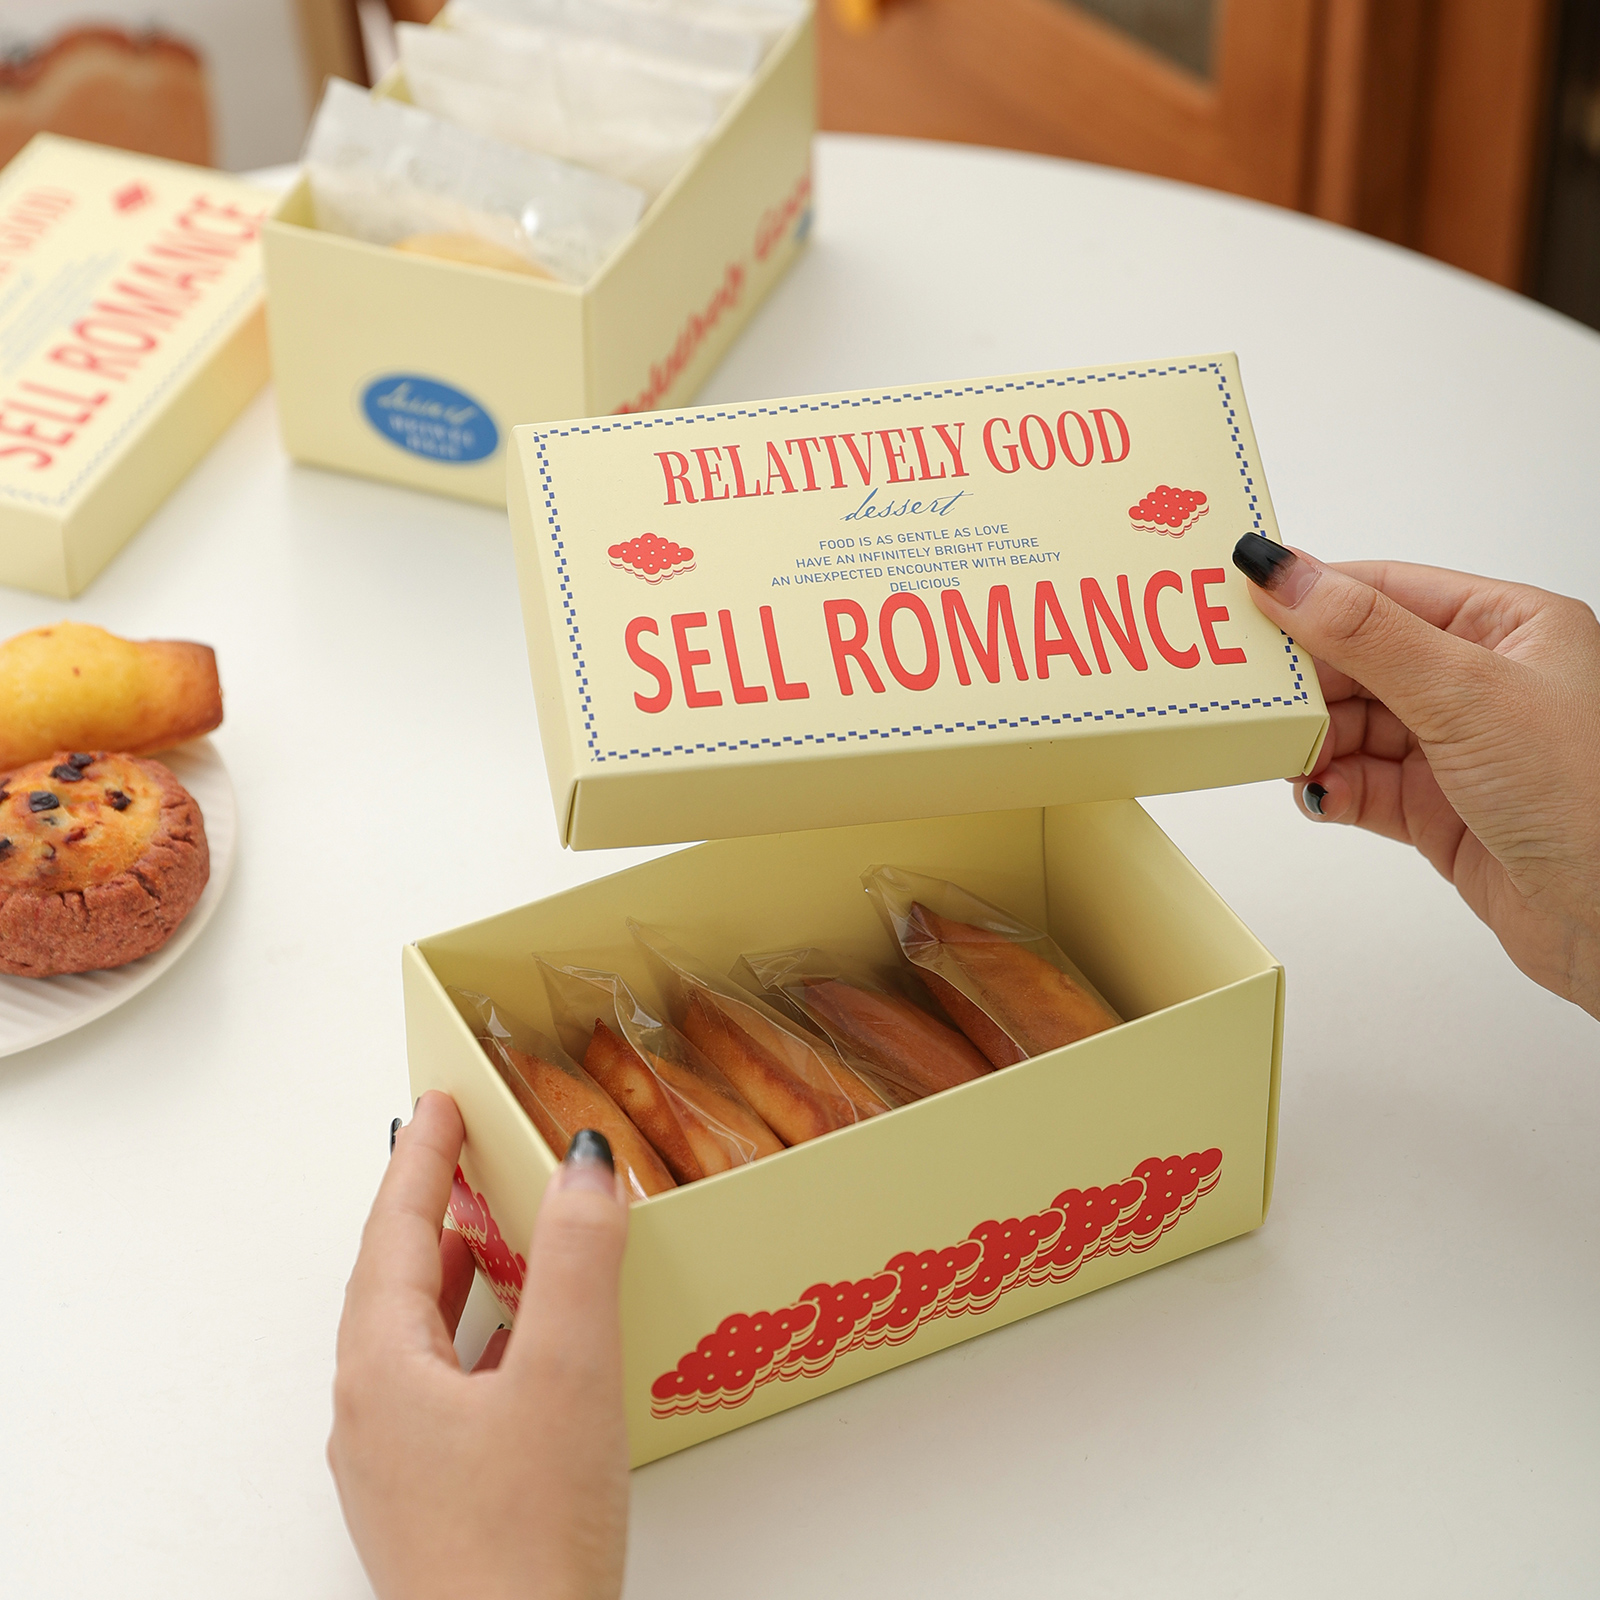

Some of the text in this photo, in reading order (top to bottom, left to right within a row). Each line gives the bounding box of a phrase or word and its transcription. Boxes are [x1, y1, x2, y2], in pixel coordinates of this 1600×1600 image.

[654, 408, 1131, 505] RELATIVELY GOOD
[840, 487, 974, 521] dessert
[796, 537, 1040, 568] HAVE AN INFINITELY BRIGHT FUTURE
[819, 523, 1010, 550] FOOD IS AS GENTLE AS LOVE
[771, 551, 1062, 587] AN UNEXPECTED ENCOUNTER WITH BEAUTY
[889, 577, 961, 593] DELICIOUS
[624, 567, 1247, 714] SELL ROMANCE
